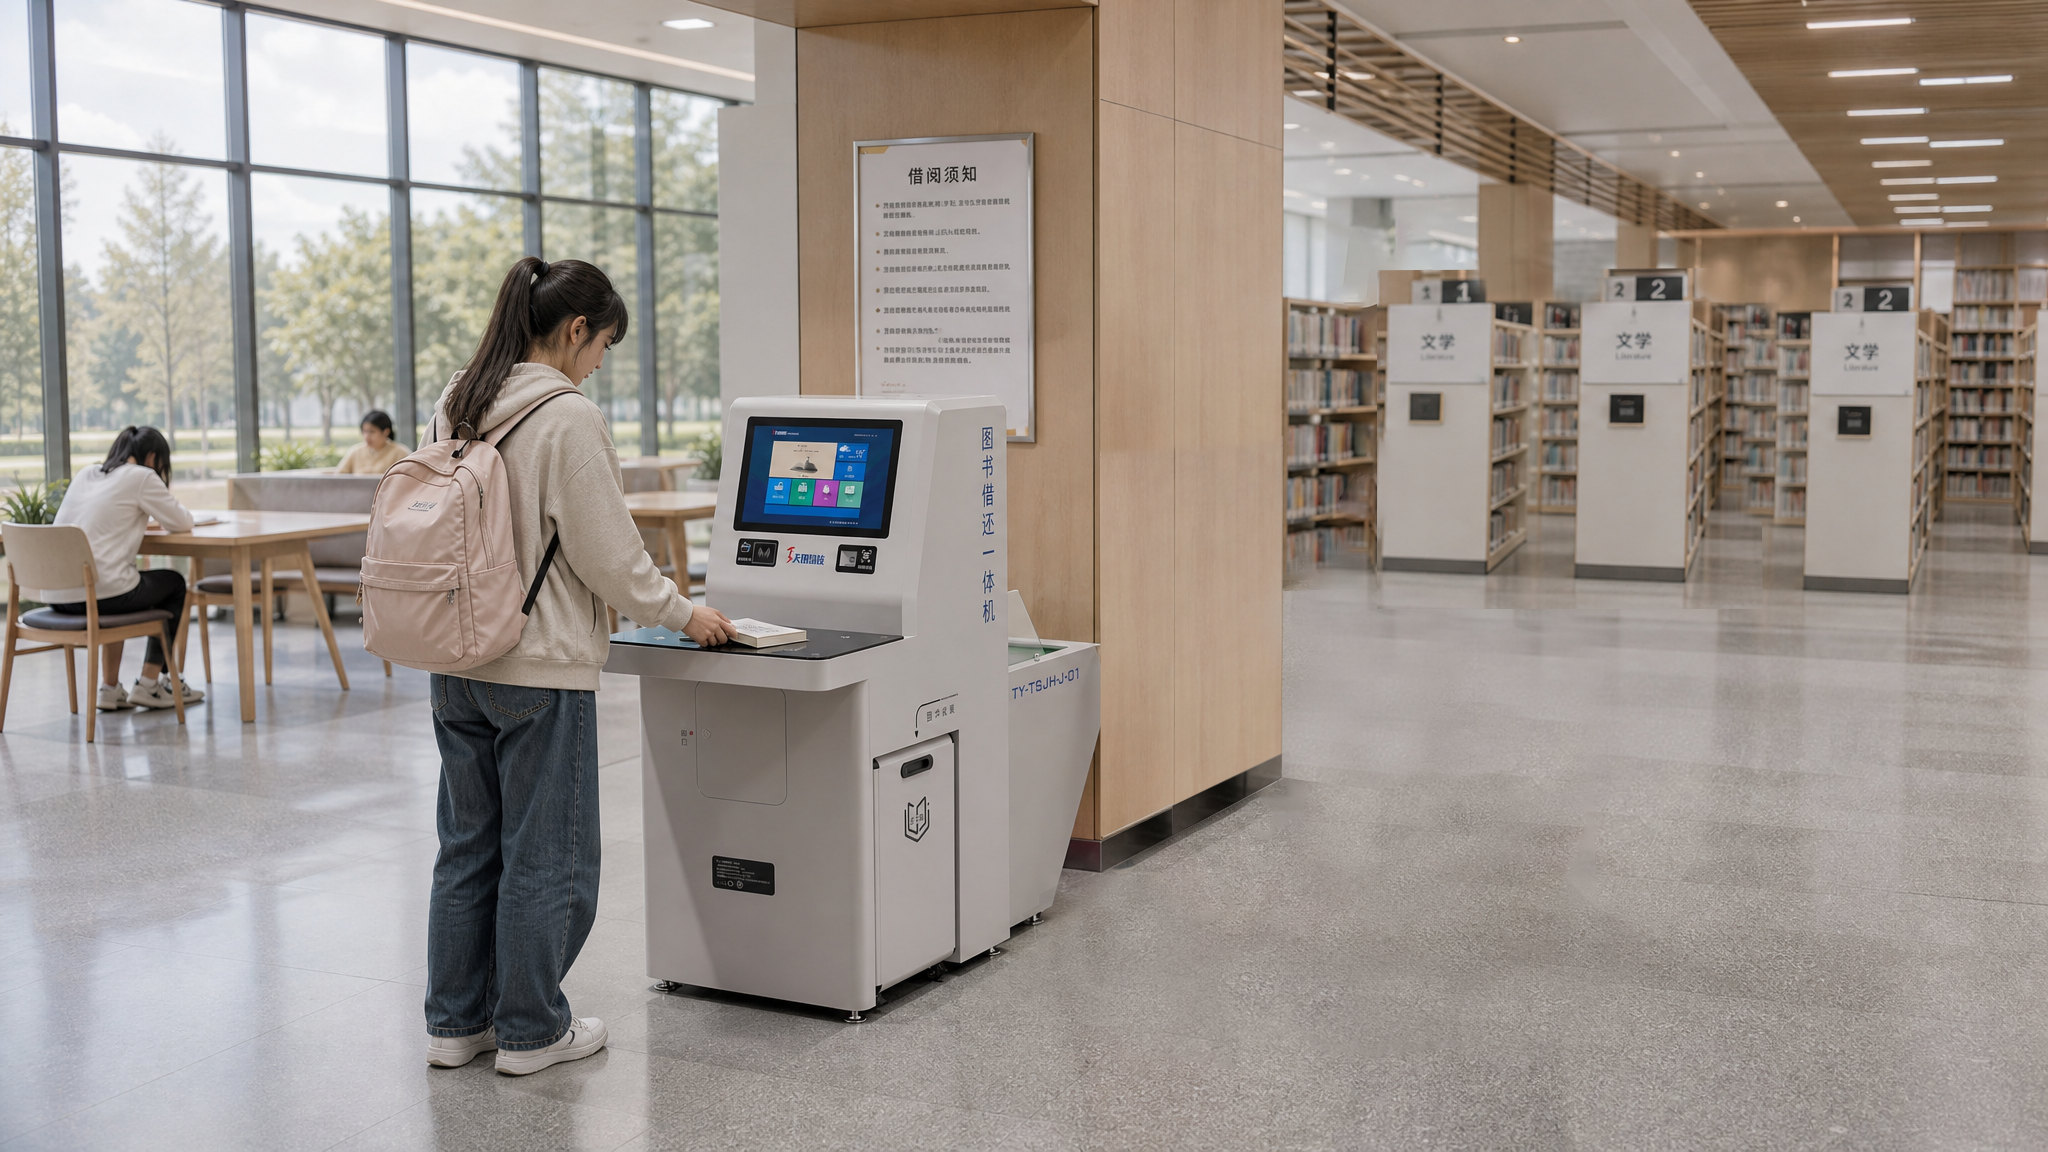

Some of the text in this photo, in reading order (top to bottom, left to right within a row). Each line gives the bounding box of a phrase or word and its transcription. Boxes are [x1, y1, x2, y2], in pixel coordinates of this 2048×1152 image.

[908, 165, 977, 185] 借阅须知
[1456, 282, 1472, 303] 1
[1614, 282, 1625, 298] 2
[1650, 278, 1666, 300] 2
[1843, 293, 1853, 309] 2
[1877, 289, 1894, 311] 2
[1420, 333, 1456, 351] 文学
[1615, 332, 1652, 350] 文学
[1844, 343, 1879, 361] 文学
[981, 426, 996, 624] 图书借还一体机
